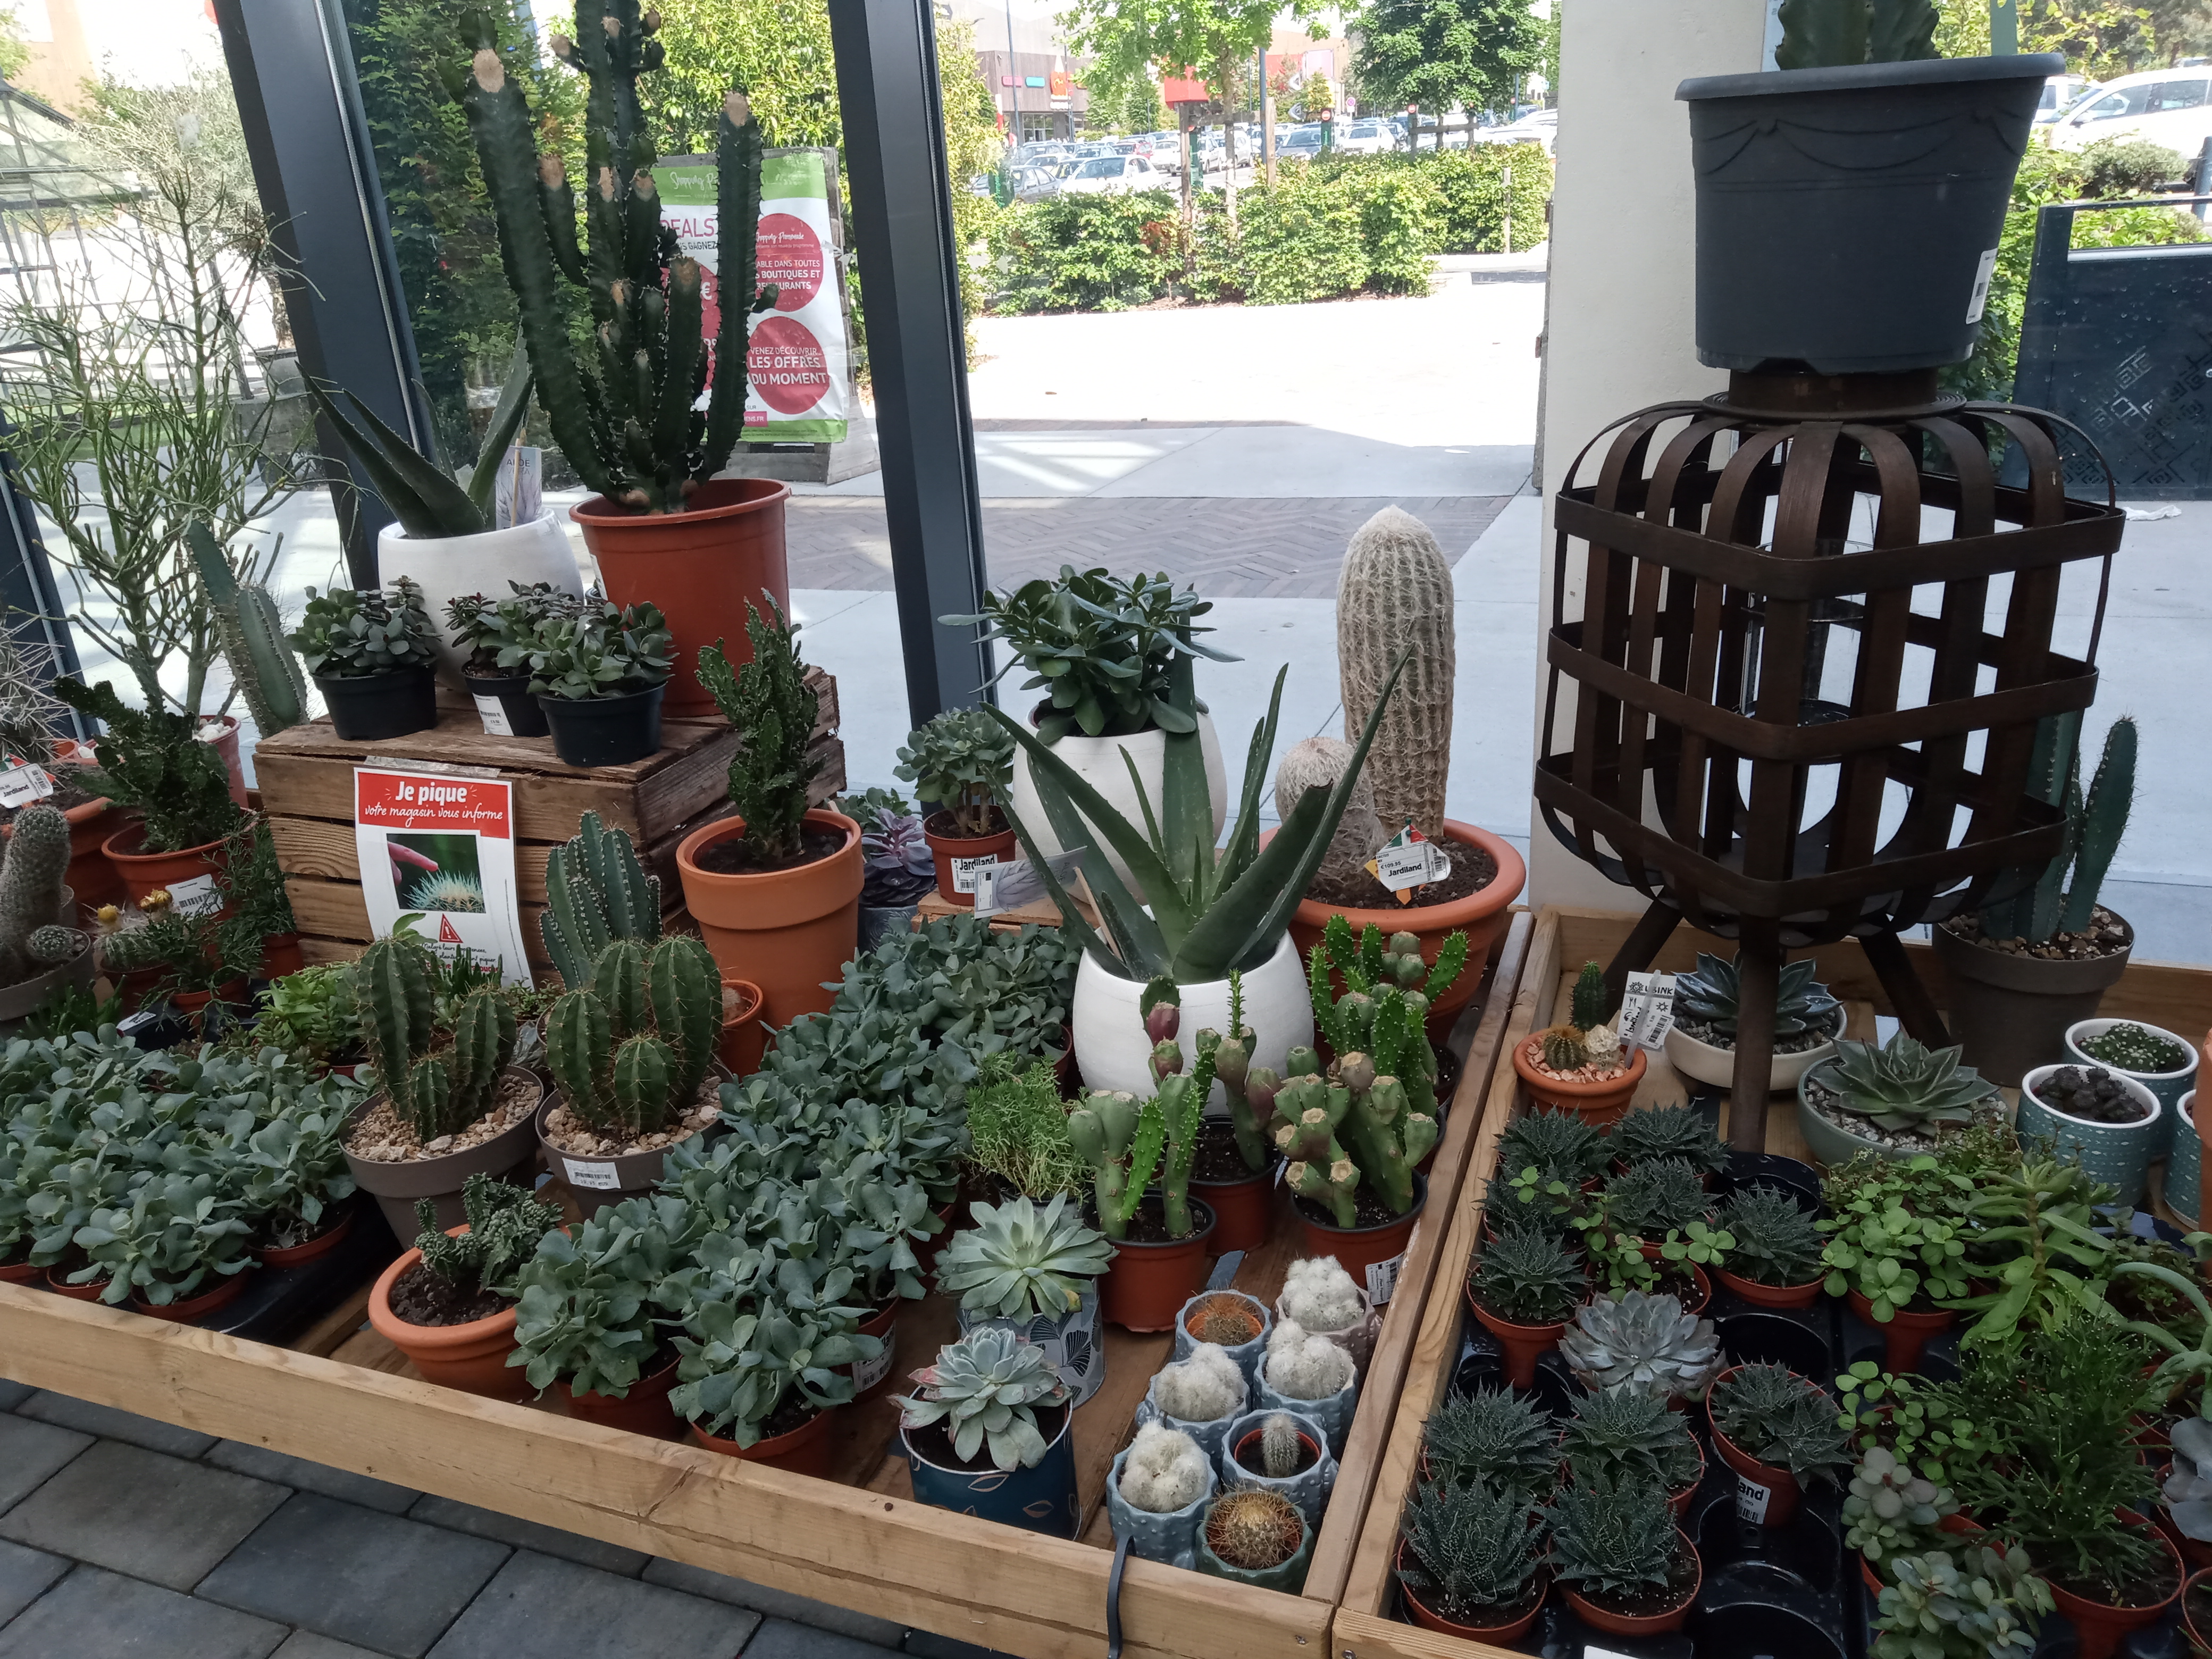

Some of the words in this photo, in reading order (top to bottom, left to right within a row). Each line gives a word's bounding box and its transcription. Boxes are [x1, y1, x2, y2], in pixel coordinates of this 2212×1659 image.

[670, 171, 704, 190] Shopping
[778, 231, 804, 243] Promenade
[688, 241, 716, 250] GAGNEZ
[761, 270, 808, 280] BOUTIQUES
[810, 270, 820, 278] ET
[757, 282, 811, 290] REURANTS
[776, 346, 818, 355] DÉCOUVRIR
[750, 356, 770, 368] LES
[774, 356, 821, 368] OFFRES
[751, 373, 767, 385] DU
[769, 373, 826, 385] MOMENT
[4, 784, 30, 797] Jardiland
[395, 781, 415, 801] Je
[418, 782, 467, 806] pique
[365, 802, 387, 816] votre
[389, 805, 435, 828] magasin
[438, 807, 459, 819] vous
[462, 802, 503, 823] informe
[960, 854, 995, 870] Jardiland
[1380, 861, 1401, 869] €109.95
[1388, 863, 1422, 877] Jardiland
